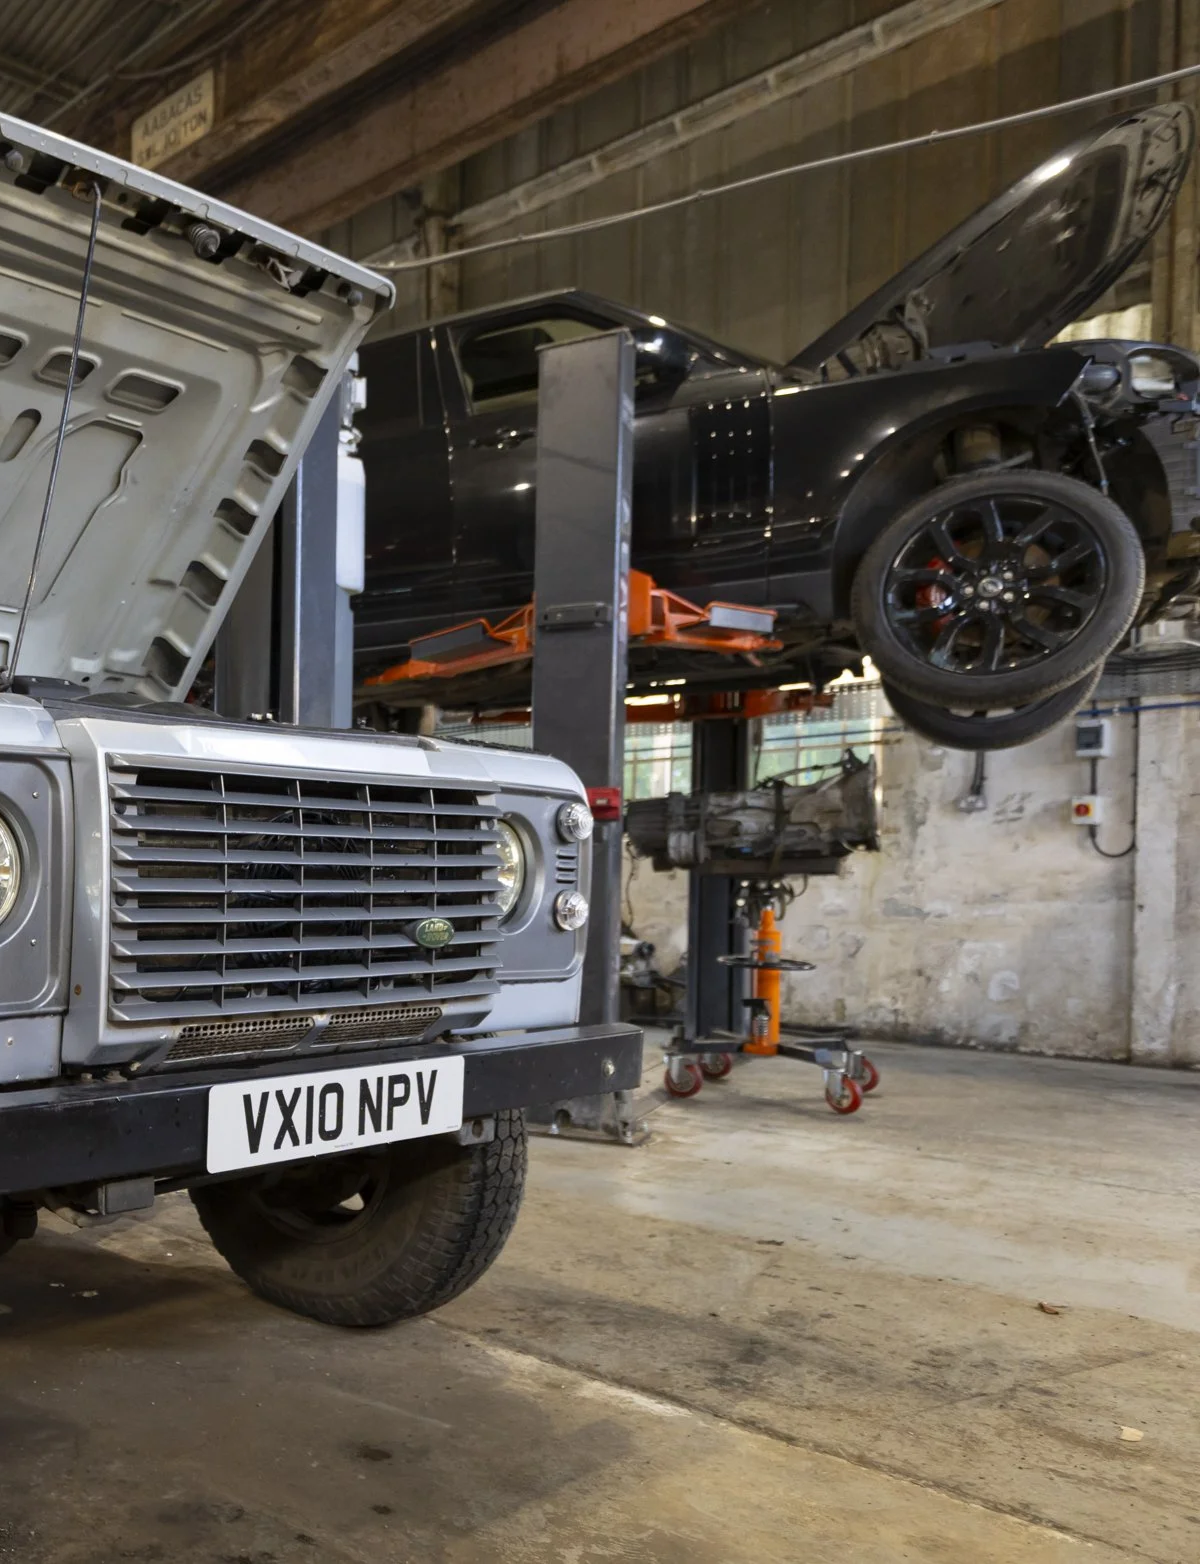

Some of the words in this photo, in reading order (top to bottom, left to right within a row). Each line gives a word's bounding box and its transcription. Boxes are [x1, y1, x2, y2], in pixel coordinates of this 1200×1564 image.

[425, 922, 444, 932] LAND
[243, 1081, 345, 1154] VX10
[358, 1069, 438, 1136] NPV
